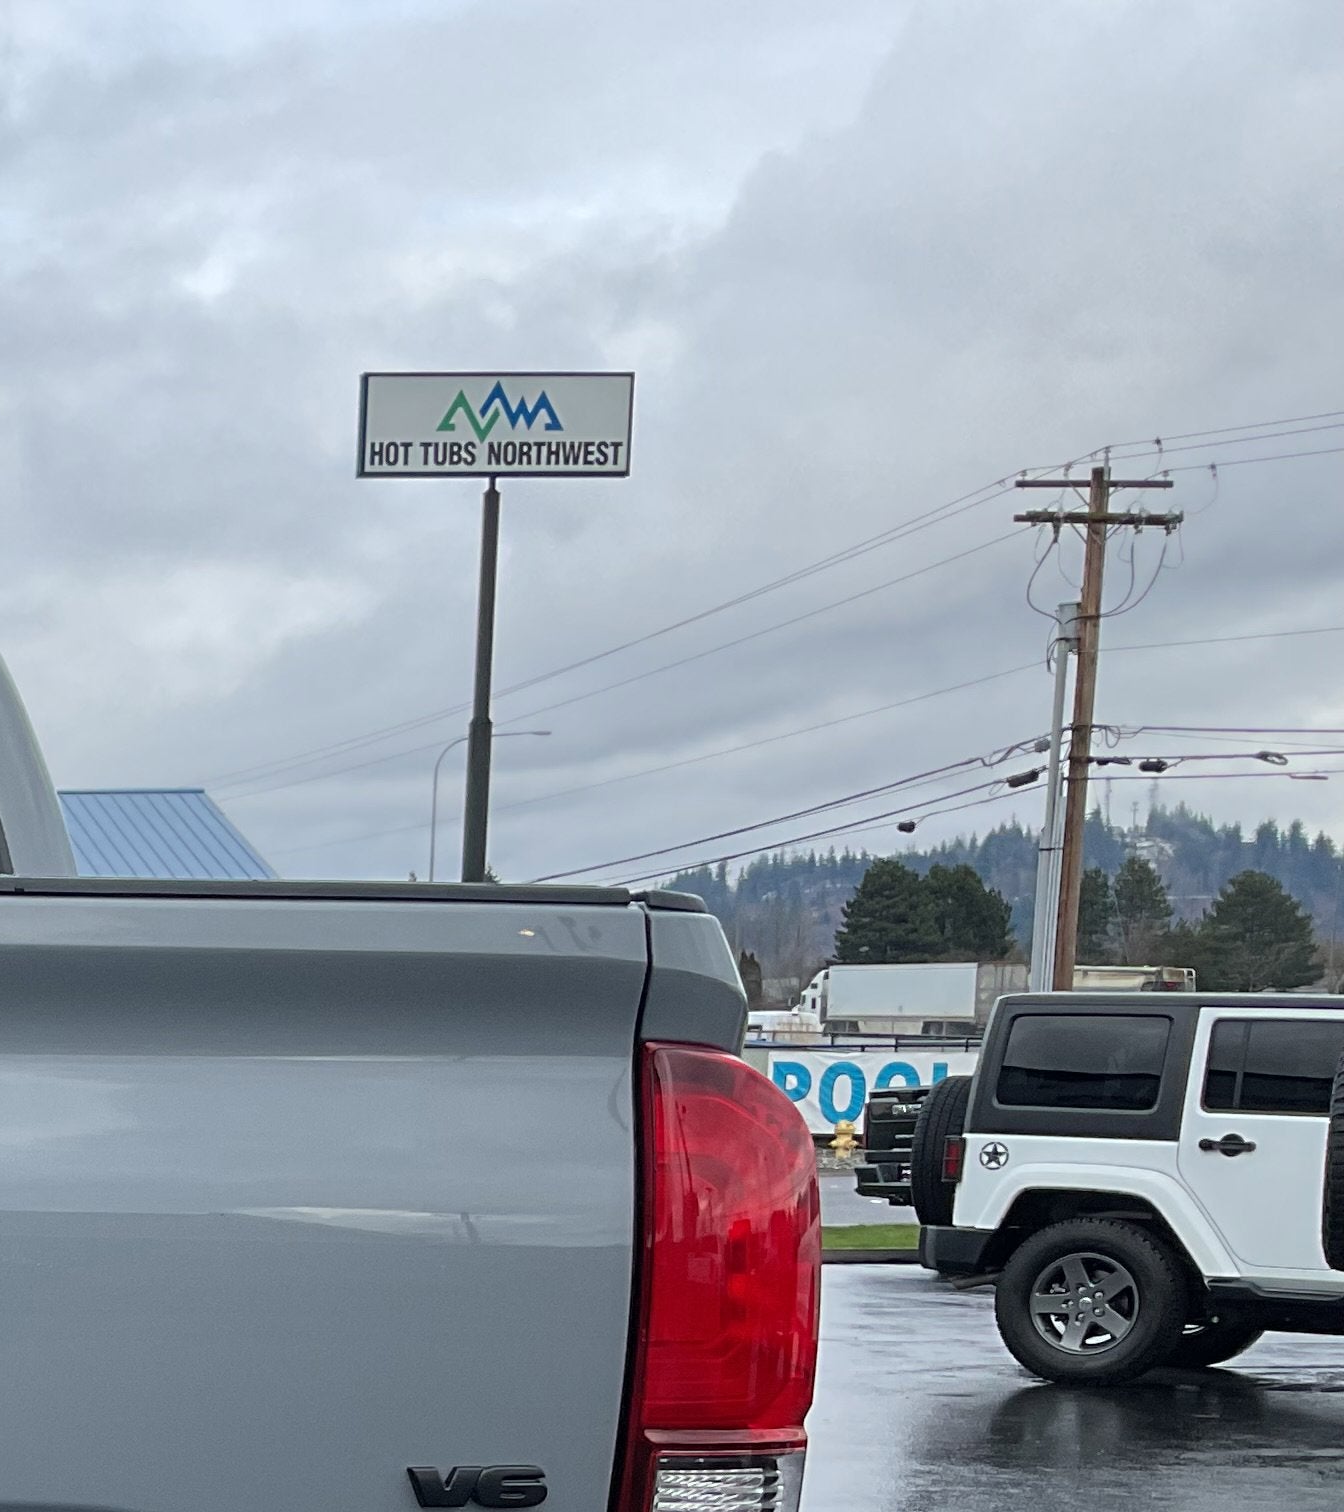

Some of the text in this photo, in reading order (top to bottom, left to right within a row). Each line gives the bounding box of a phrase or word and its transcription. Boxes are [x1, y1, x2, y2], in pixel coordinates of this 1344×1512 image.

[369, 441, 624, 466] HOT TUBS NORTHWEST
[406, 1464, 549, 1509] V6
